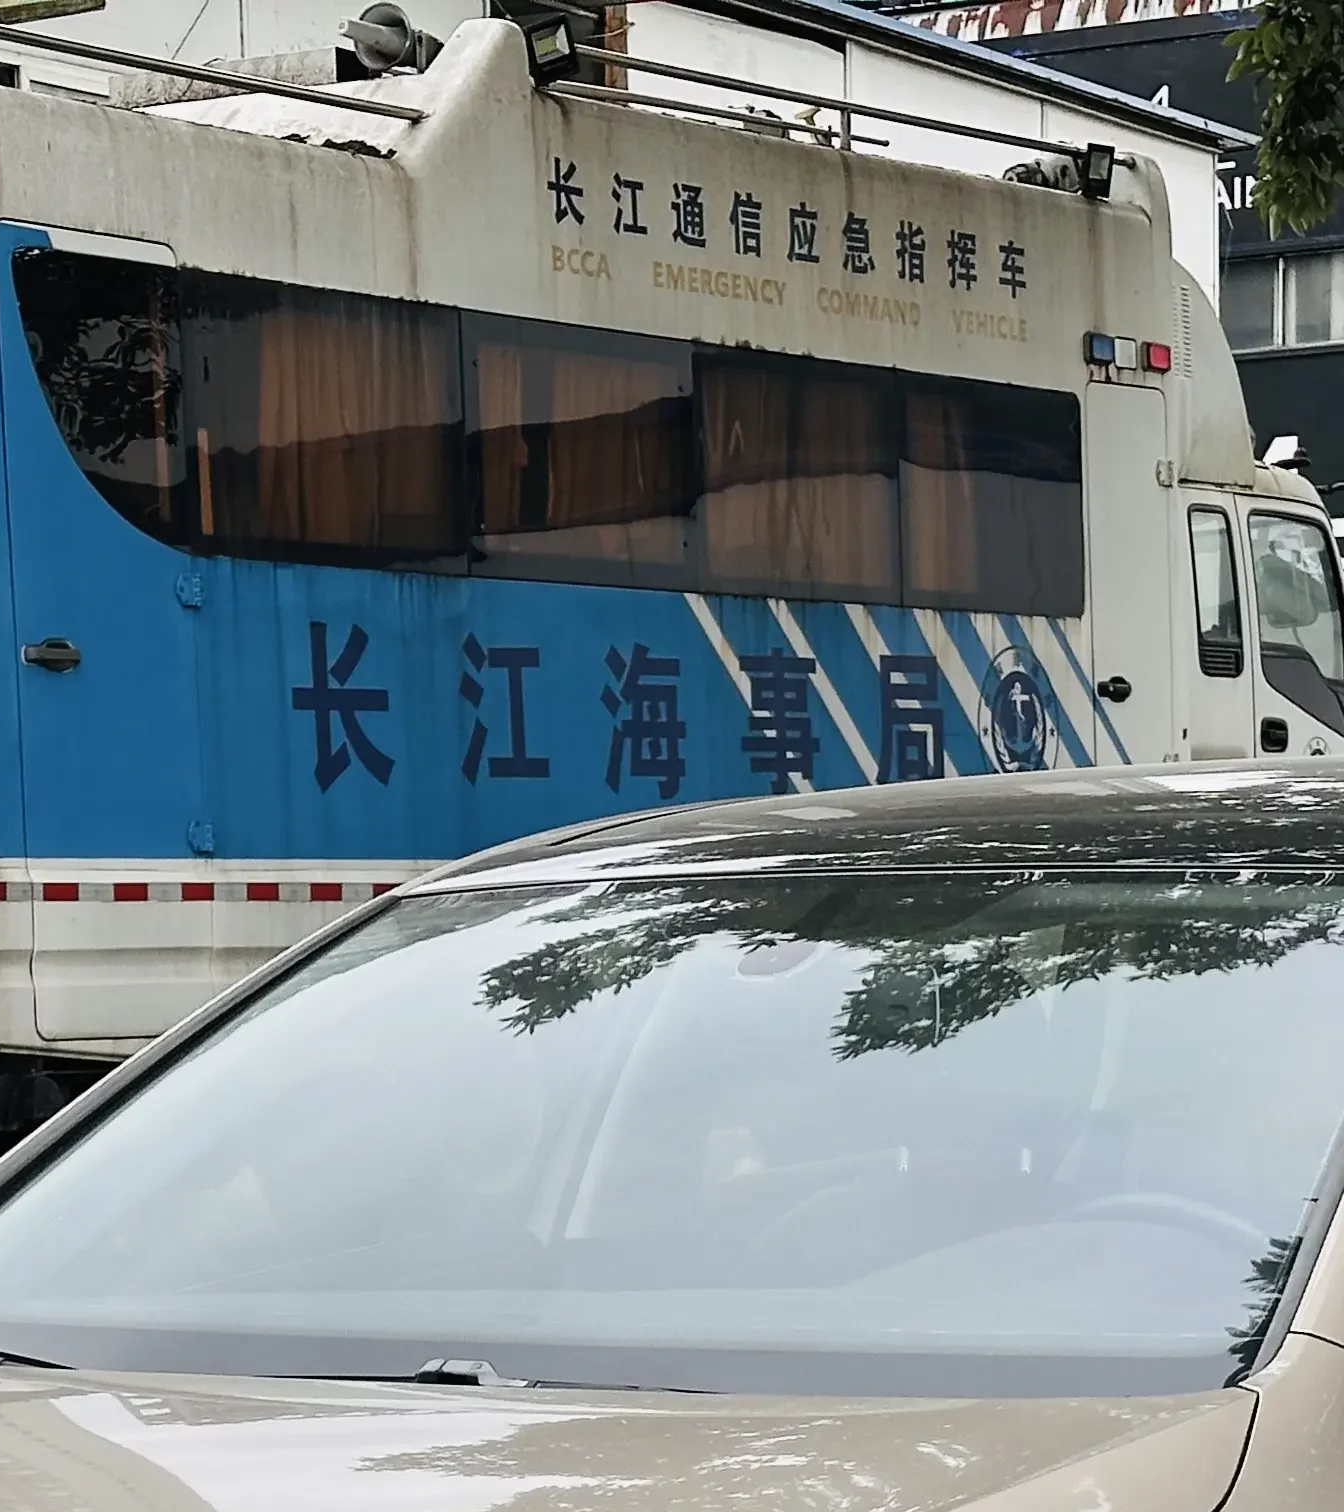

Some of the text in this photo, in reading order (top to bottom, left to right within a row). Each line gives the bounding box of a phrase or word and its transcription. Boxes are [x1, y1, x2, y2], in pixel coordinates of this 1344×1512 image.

[547, 156, 1028, 299] 长江通信应急指挥车
[551, 245, 1028, 343] BCCA EMERGENCY COMMAND VEHICLE
[291, 620, 945, 797] 长江海事局
